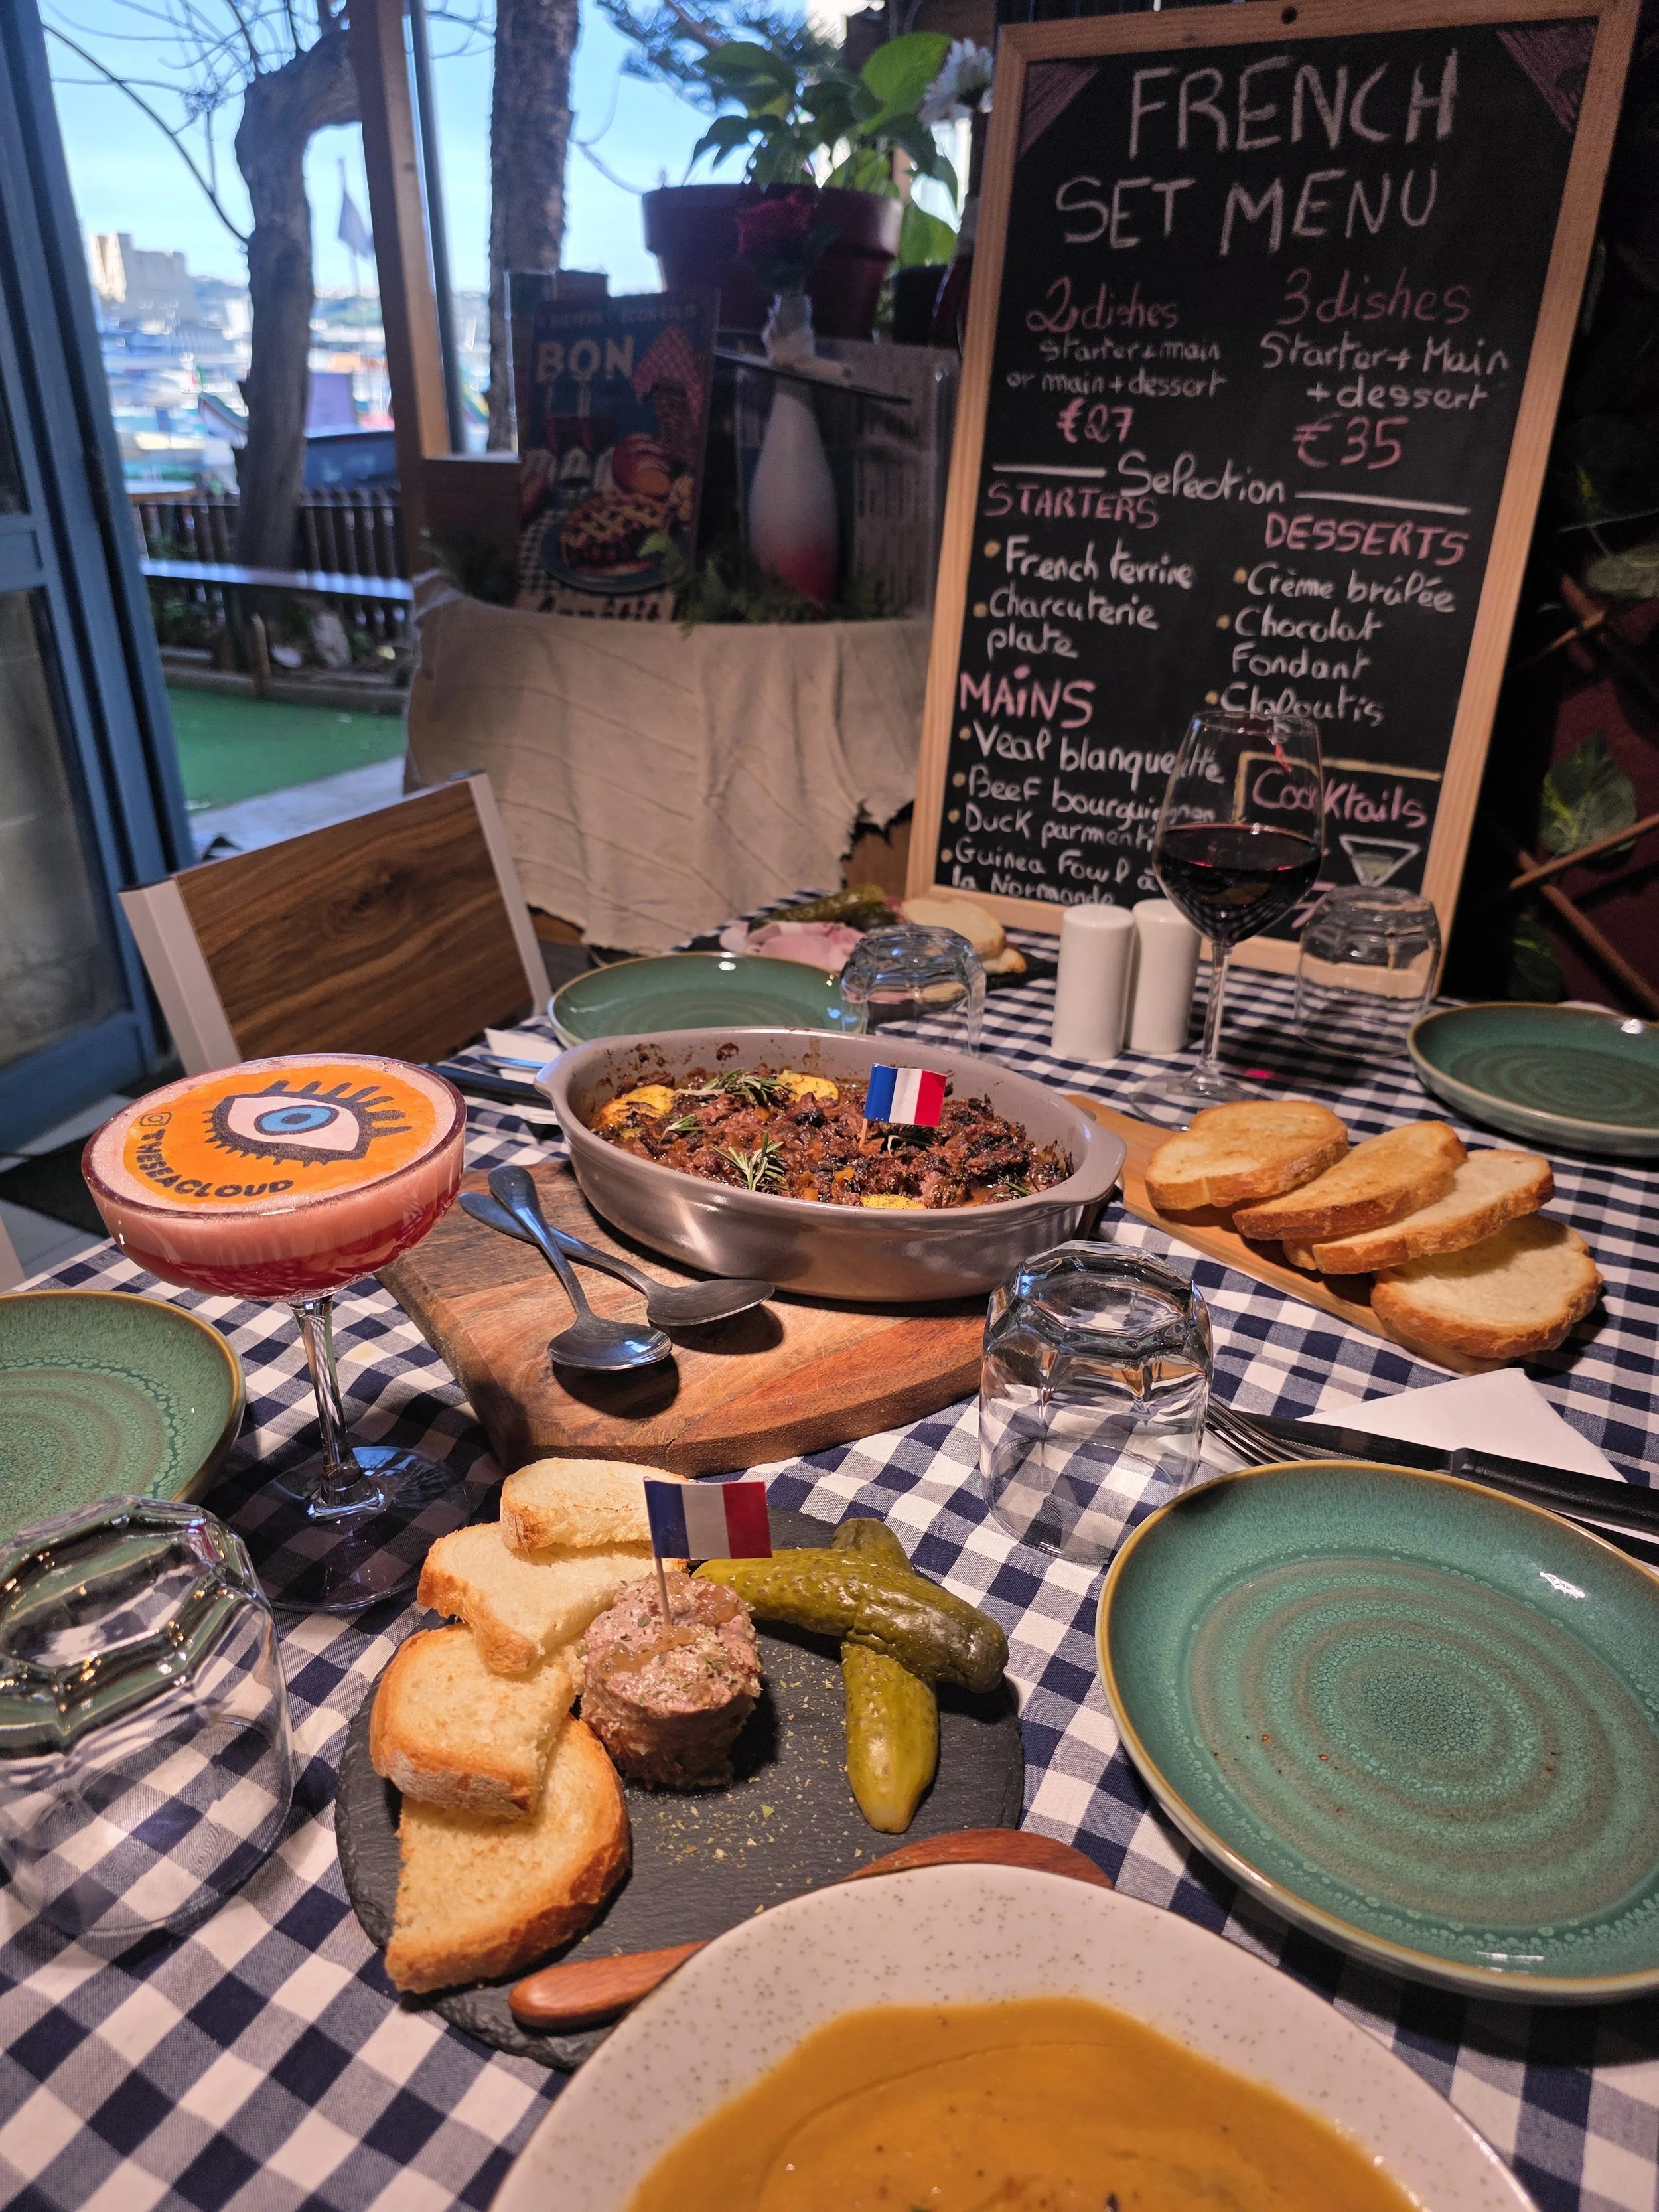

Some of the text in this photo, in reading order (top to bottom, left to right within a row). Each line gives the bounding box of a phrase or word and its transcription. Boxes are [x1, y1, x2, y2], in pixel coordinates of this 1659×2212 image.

[1129, 47, 1457, 159] FRENCH
[1056, 163, 1438, 256] SET MENU
[535, 335, 635, 385] BON
[1007, 373, 1037, 388] or
[1423, 336, 1510, 376] Main
[1291, 411, 1409, 471] €35
[1118, 449, 1286, 504] Selection
[984, 480, 1161, 530] STARTERS
[1005, 535, 1194, 589] French terrine
[1264, 510, 1471, 567] DESSERTS
[989, 579, 1160, 630] Charcuterie
[1247, 561, 1334, 599] Crème
[987, 621, 1080, 661] plate
[1235, 603, 1384, 642] Chocolat
[1232, 640, 1373, 679] Fondant
[973, 719, 1052, 761] Veal
[955, 837, 1046, 875] Guinea
[1058, 849, 1130, 886] Fowl
